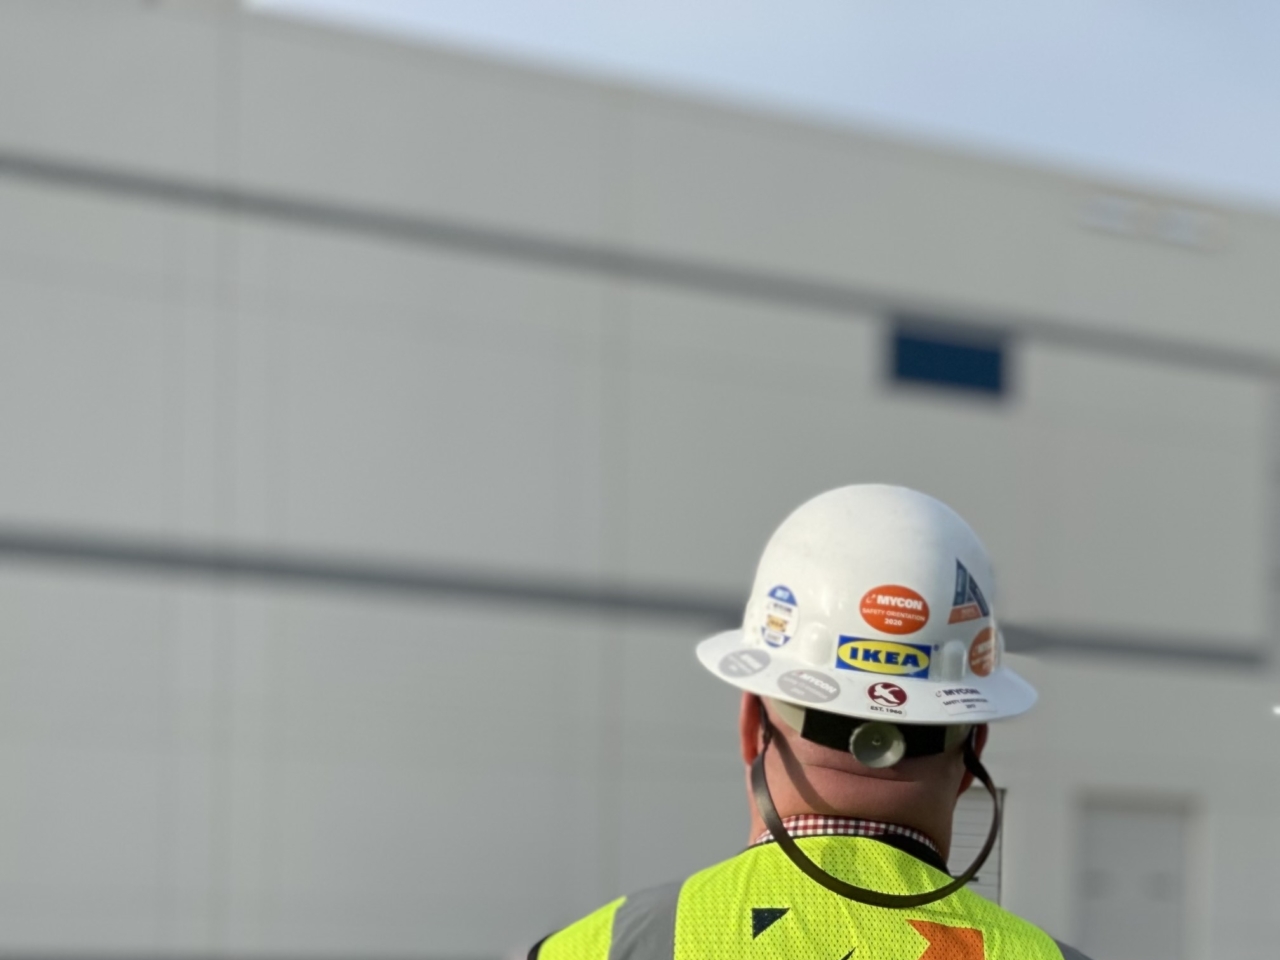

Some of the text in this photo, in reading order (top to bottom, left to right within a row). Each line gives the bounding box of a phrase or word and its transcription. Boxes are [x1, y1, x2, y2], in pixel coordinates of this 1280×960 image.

[877, 595, 923, 610] MYCON
[862, 607, 926, 621] SAFETY ORIENTATION
[884, 618, 903, 626] 2020
[849, 646, 920, 668] IKEA
[799, 672, 837, 693] MYCON
[942, 688, 981, 697] MYCON
[870, 705, 885, 713] EST.
